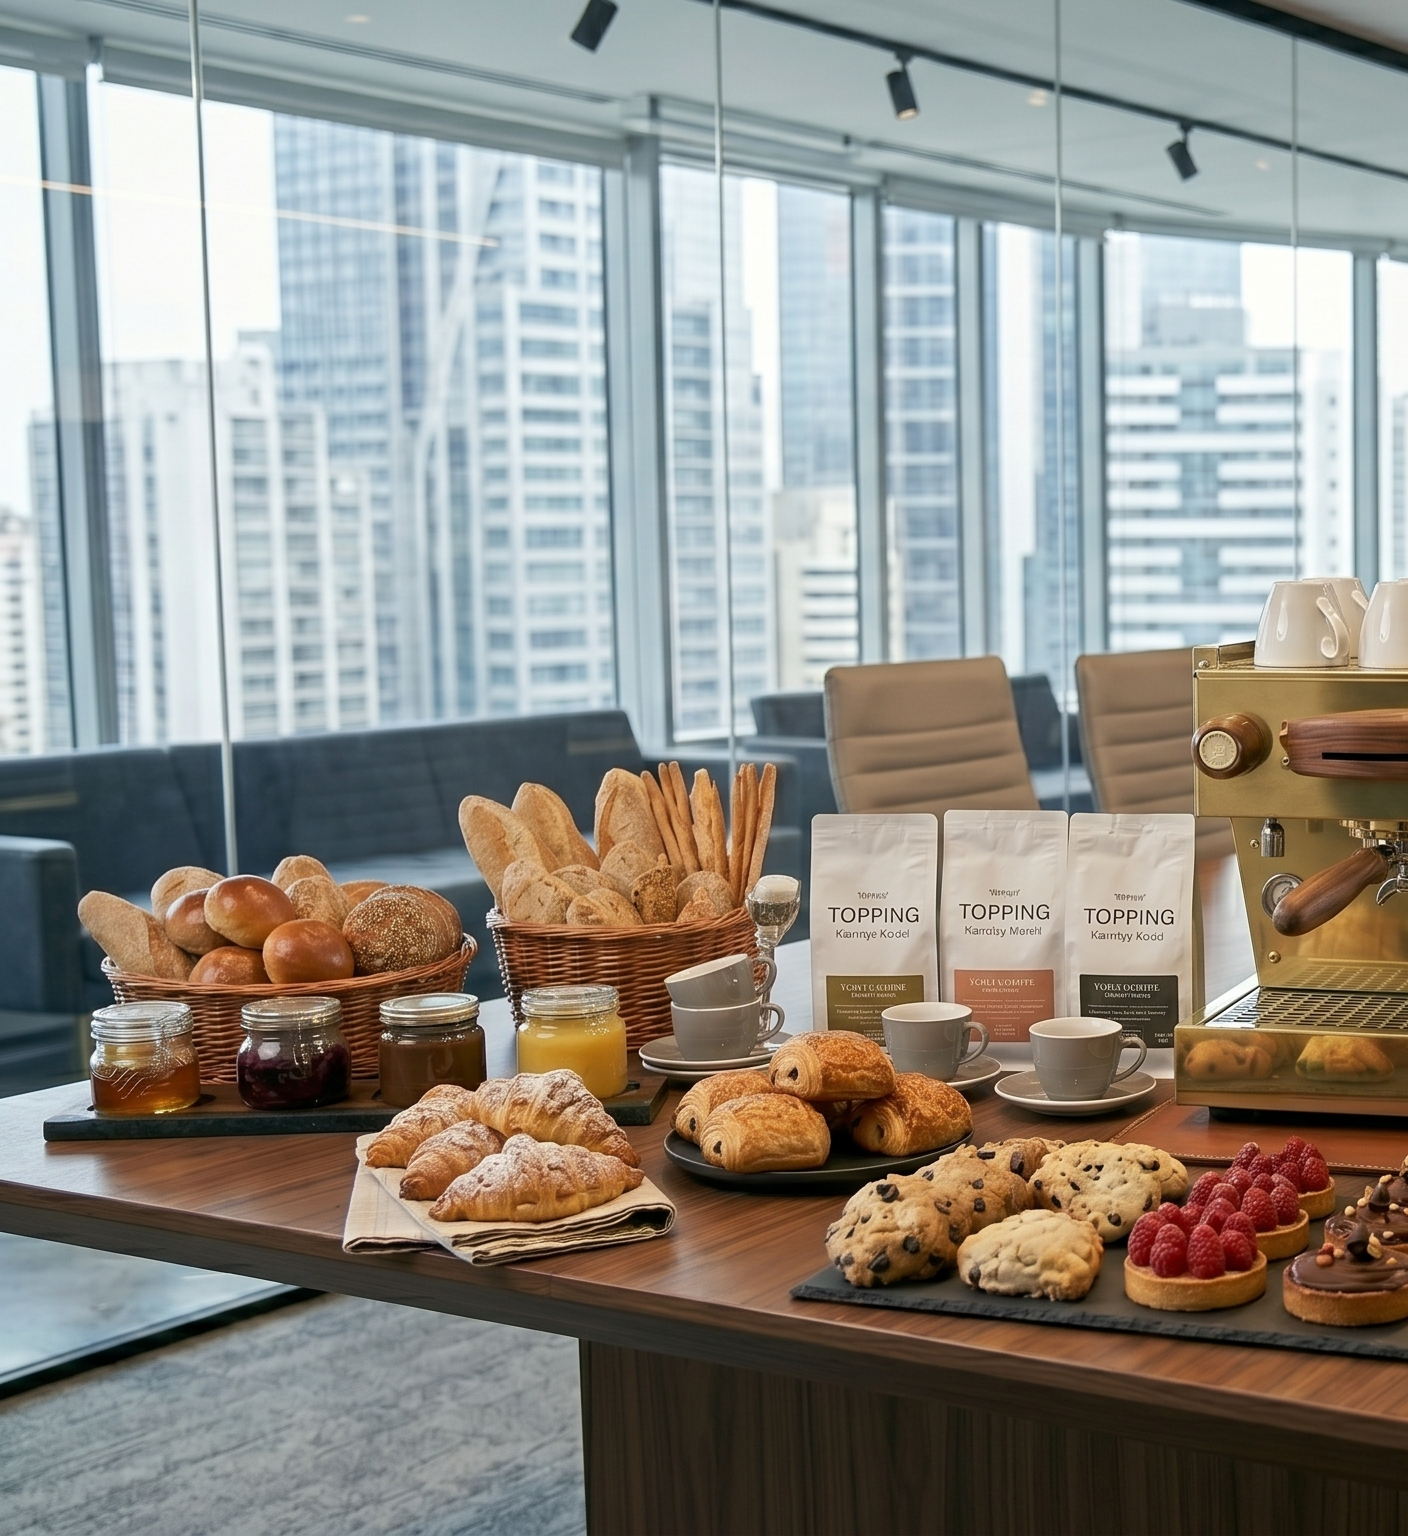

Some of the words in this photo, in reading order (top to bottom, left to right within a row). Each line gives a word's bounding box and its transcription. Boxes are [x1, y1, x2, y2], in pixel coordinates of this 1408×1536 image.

[828, 907, 920, 924] TOPPING
[959, 903, 1050, 921] TOPPING
[1083, 908, 1175, 926] TOPPING
